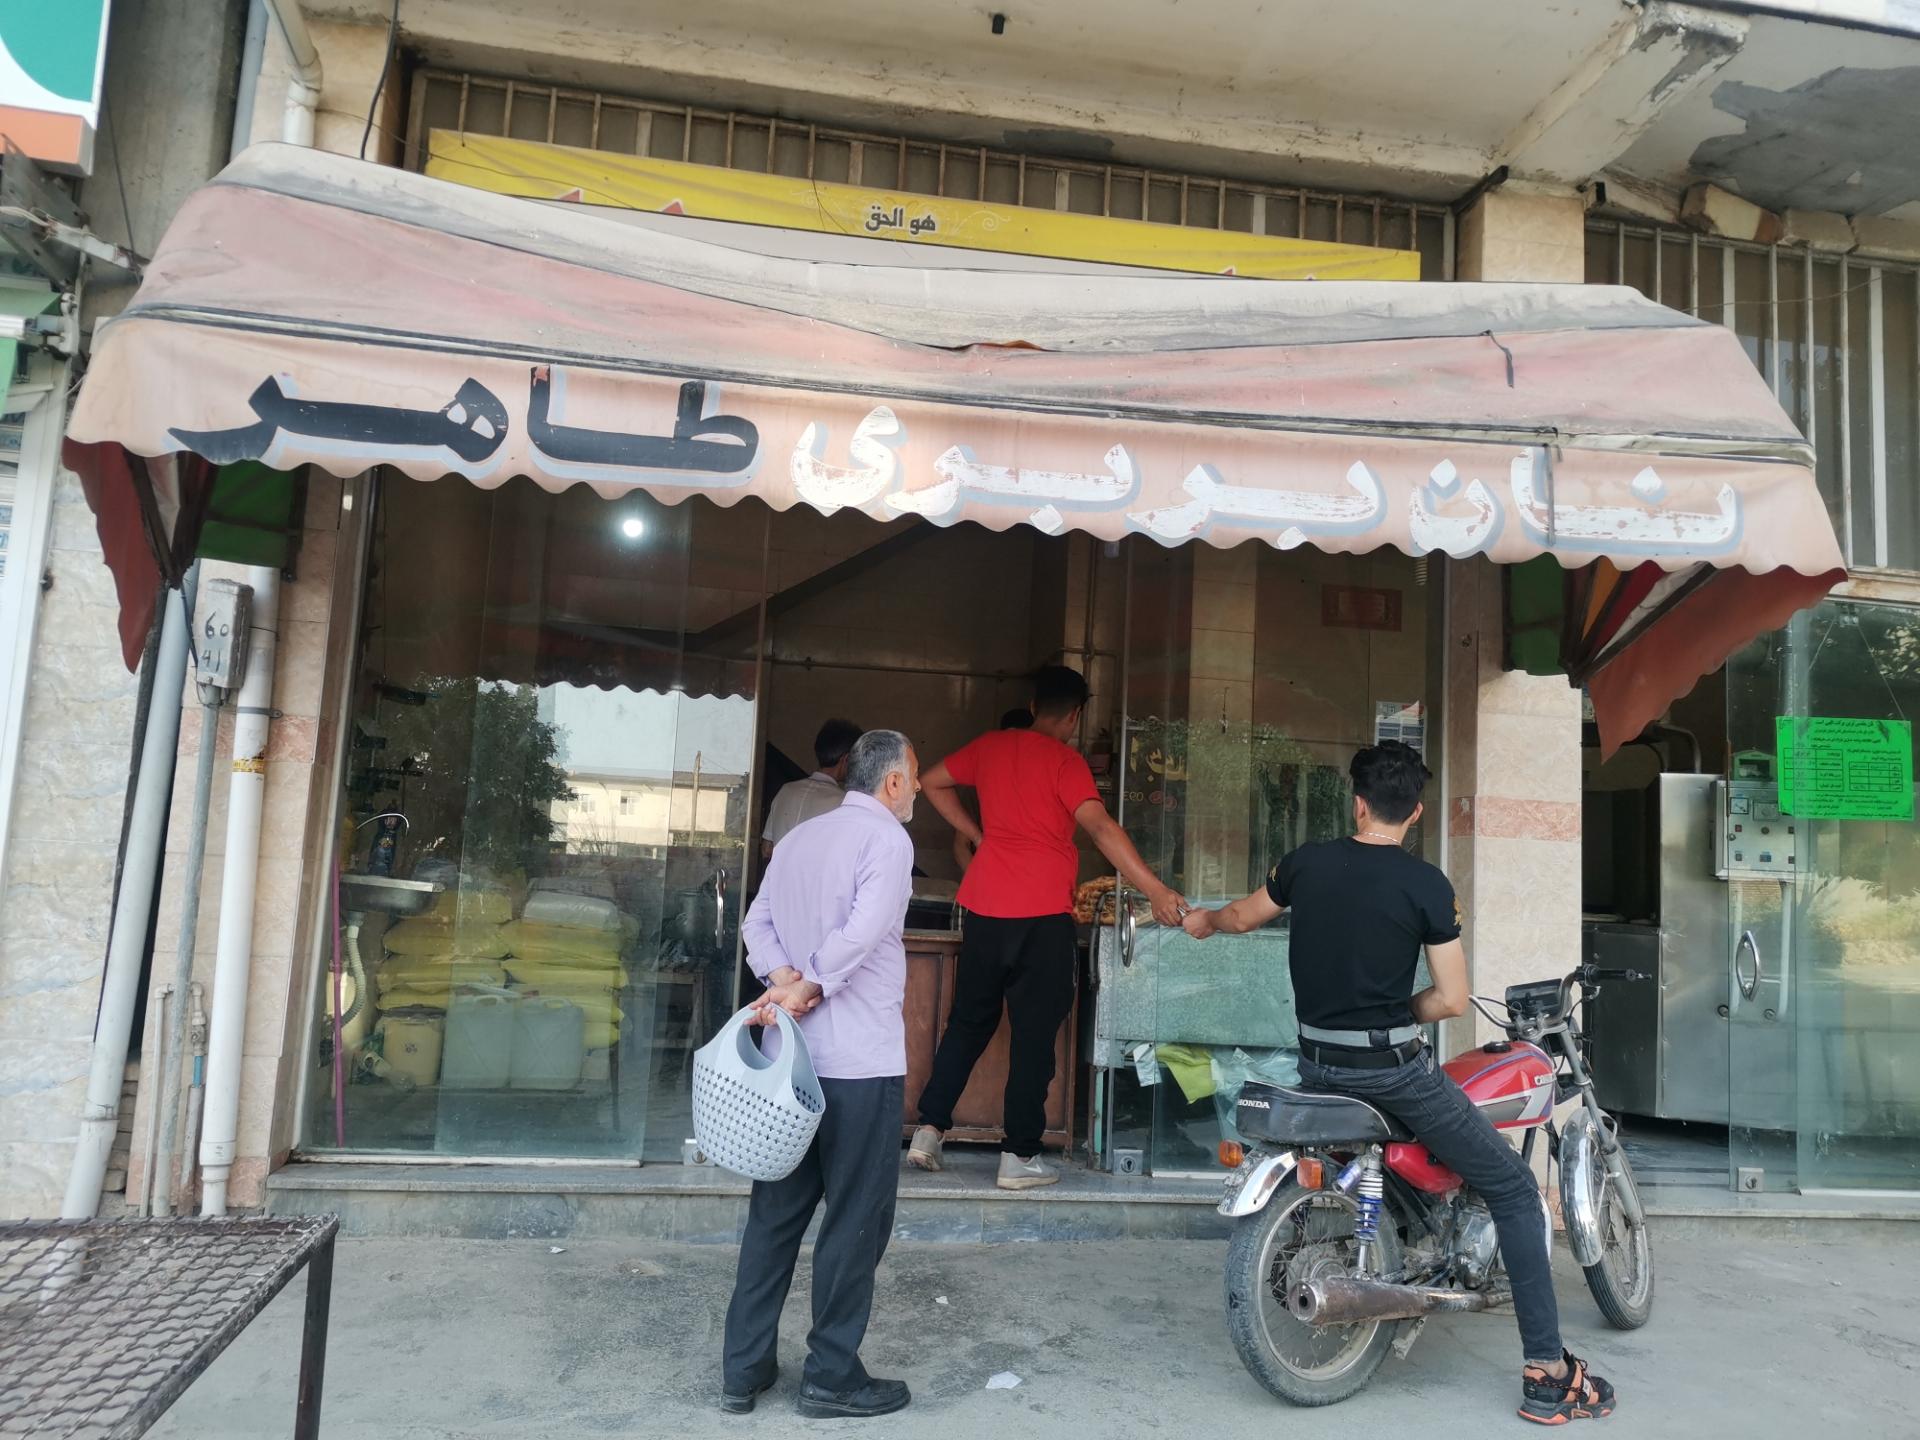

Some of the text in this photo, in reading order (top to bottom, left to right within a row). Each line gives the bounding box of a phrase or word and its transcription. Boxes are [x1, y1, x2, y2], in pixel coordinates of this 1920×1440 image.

[865, 205, 936, 235] هو الحق
[168, 365, 1738, 560] نان بربری طاهر
[205, 611, 229, 639] 60
[1237, 1099, 1270, 1109] HONDA
